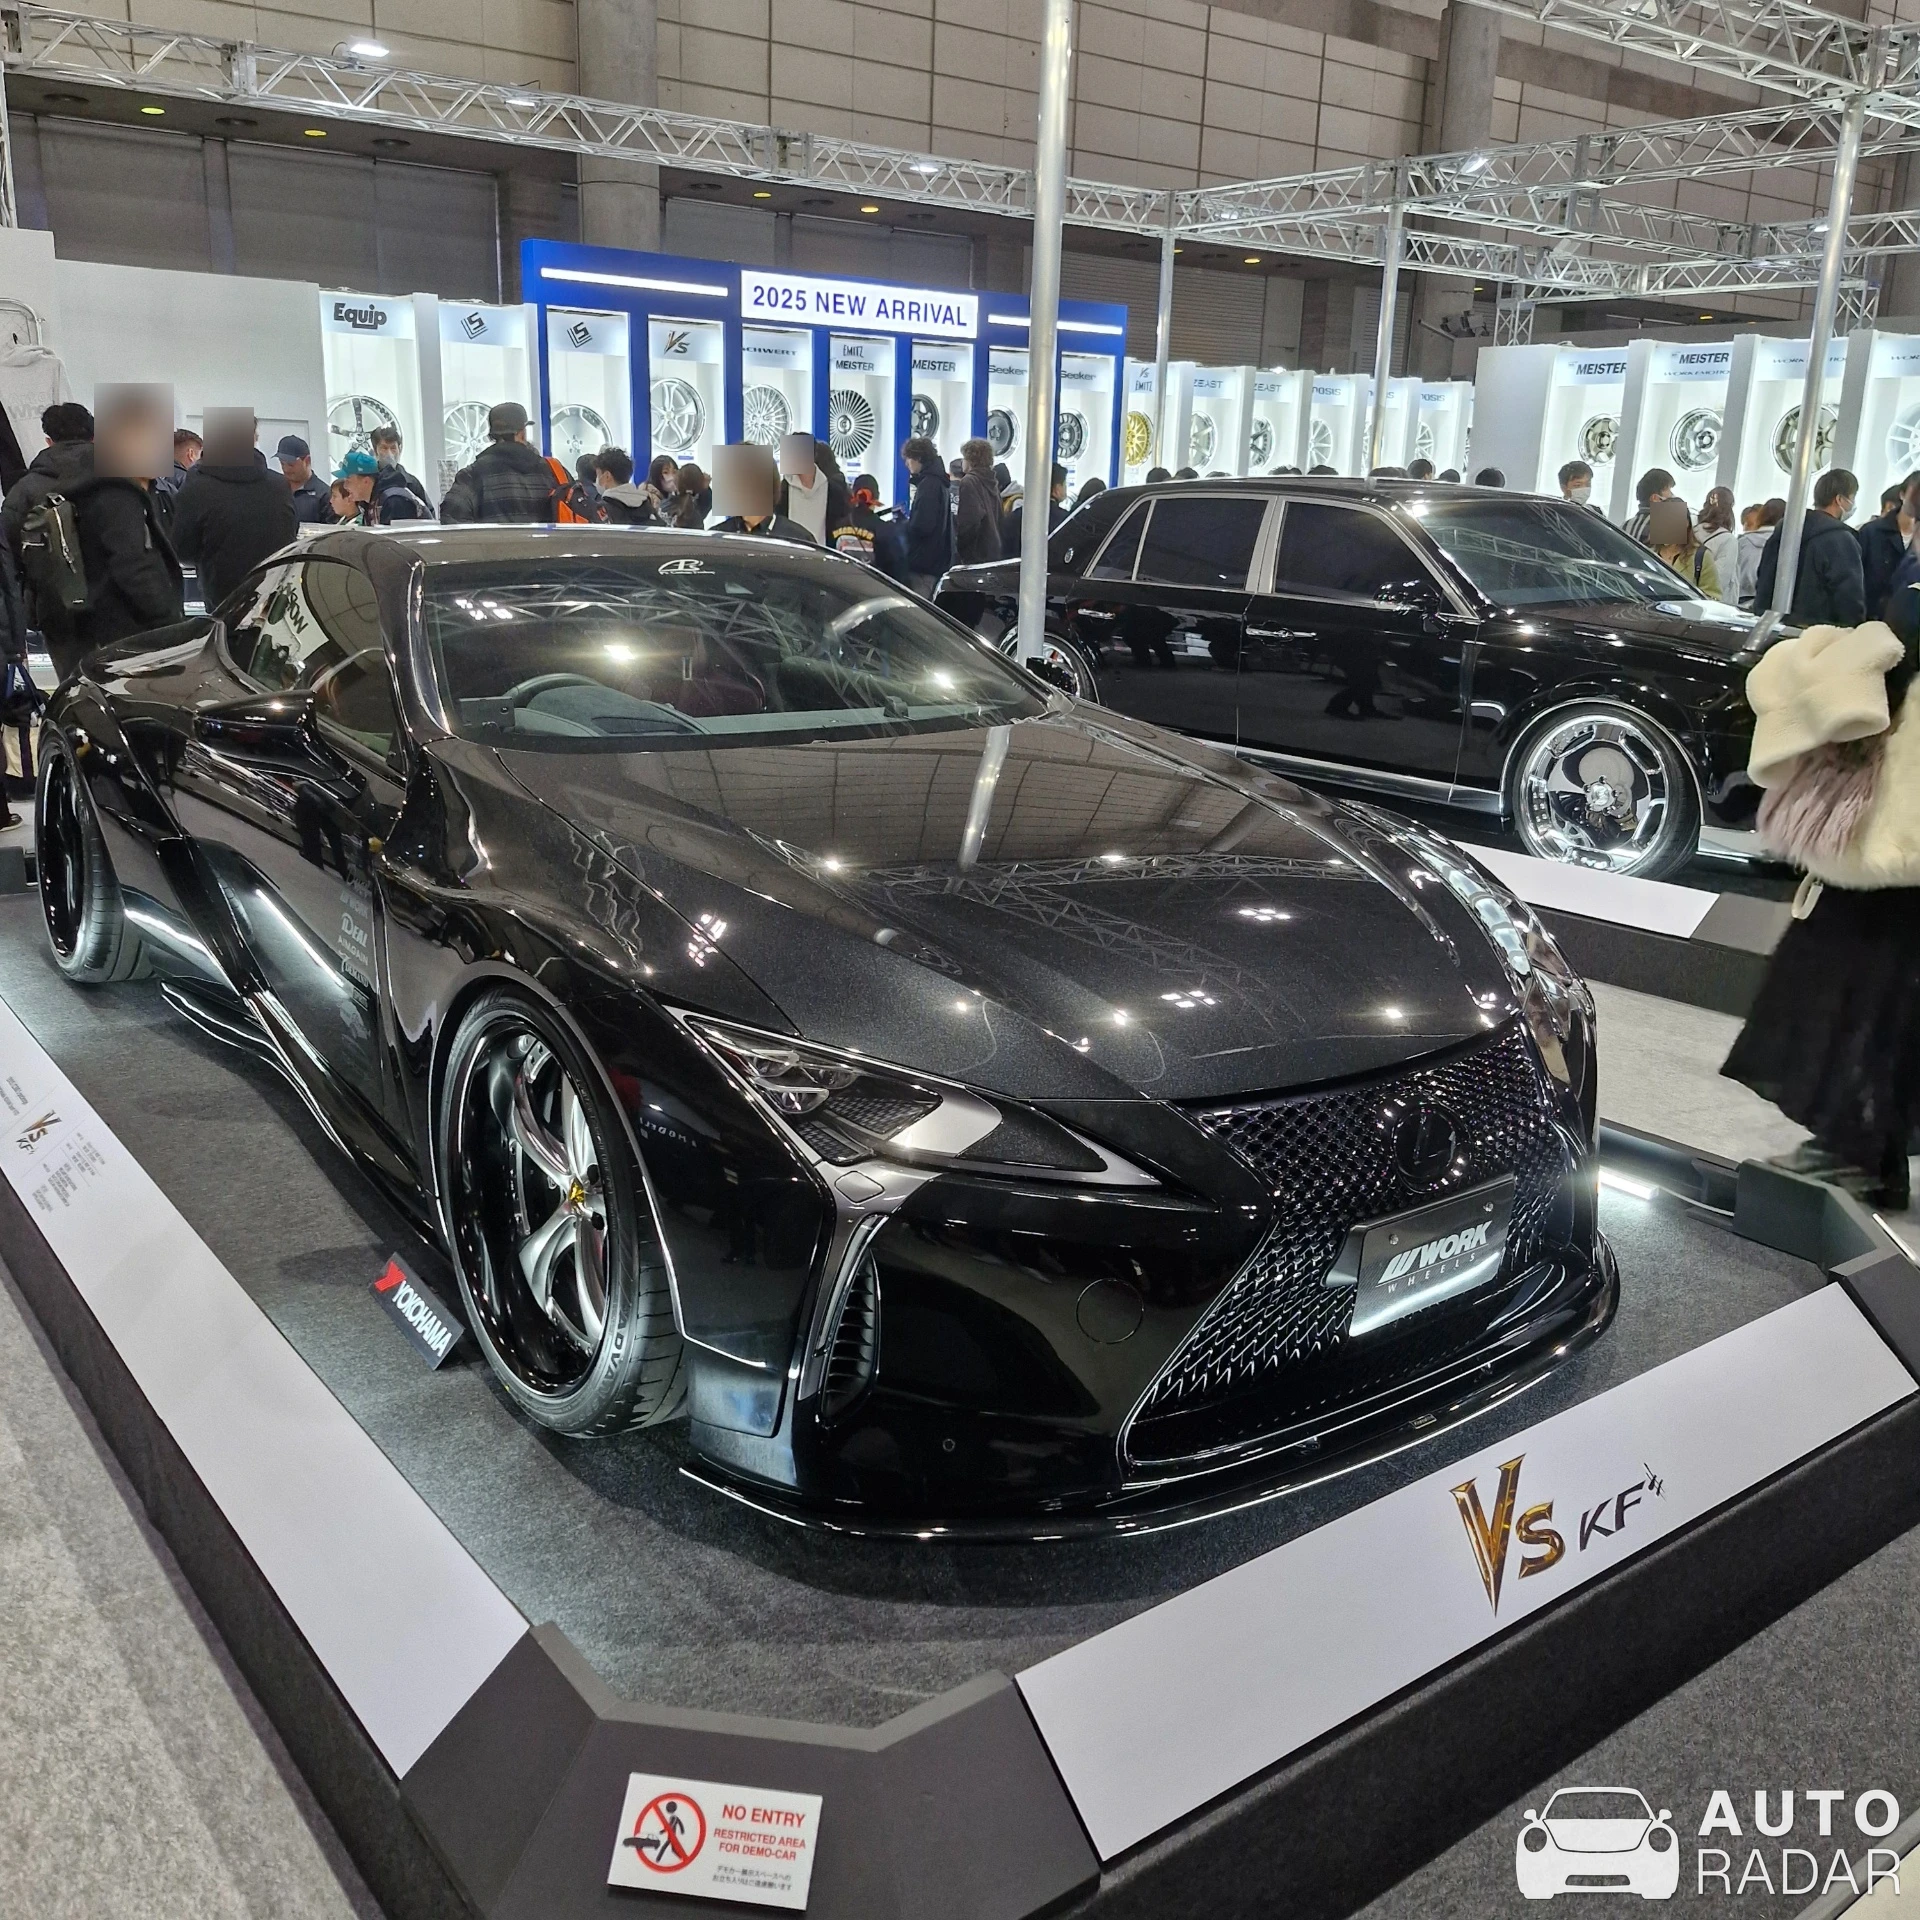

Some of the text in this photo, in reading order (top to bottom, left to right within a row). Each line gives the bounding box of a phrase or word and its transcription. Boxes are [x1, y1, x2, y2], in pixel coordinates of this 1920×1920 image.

[334, 302, 387, 330] Equip
[753, 285, 967, 326] 2025 NEW ARRIVAL
[835, 359, 874, 372] MEISTER
[912, 359, 956, 372] MEISTER
[1679, 352, 1730, 364] MEISTER
[988, 365, 1028, 376] Seeker
[1419, 1220, 1493, 1269] WORK
[1388, 1253, 1477, 1294] WHEELS
[392, 1280, 452, 1357] YOKOHAMA
[722, 1804, 806, 1829] NO ENTRY
[713, 1828, 806, 1849] RESTRICTED AREA
[719, 1842, 797, 1861] FOR DEMO-CAR
